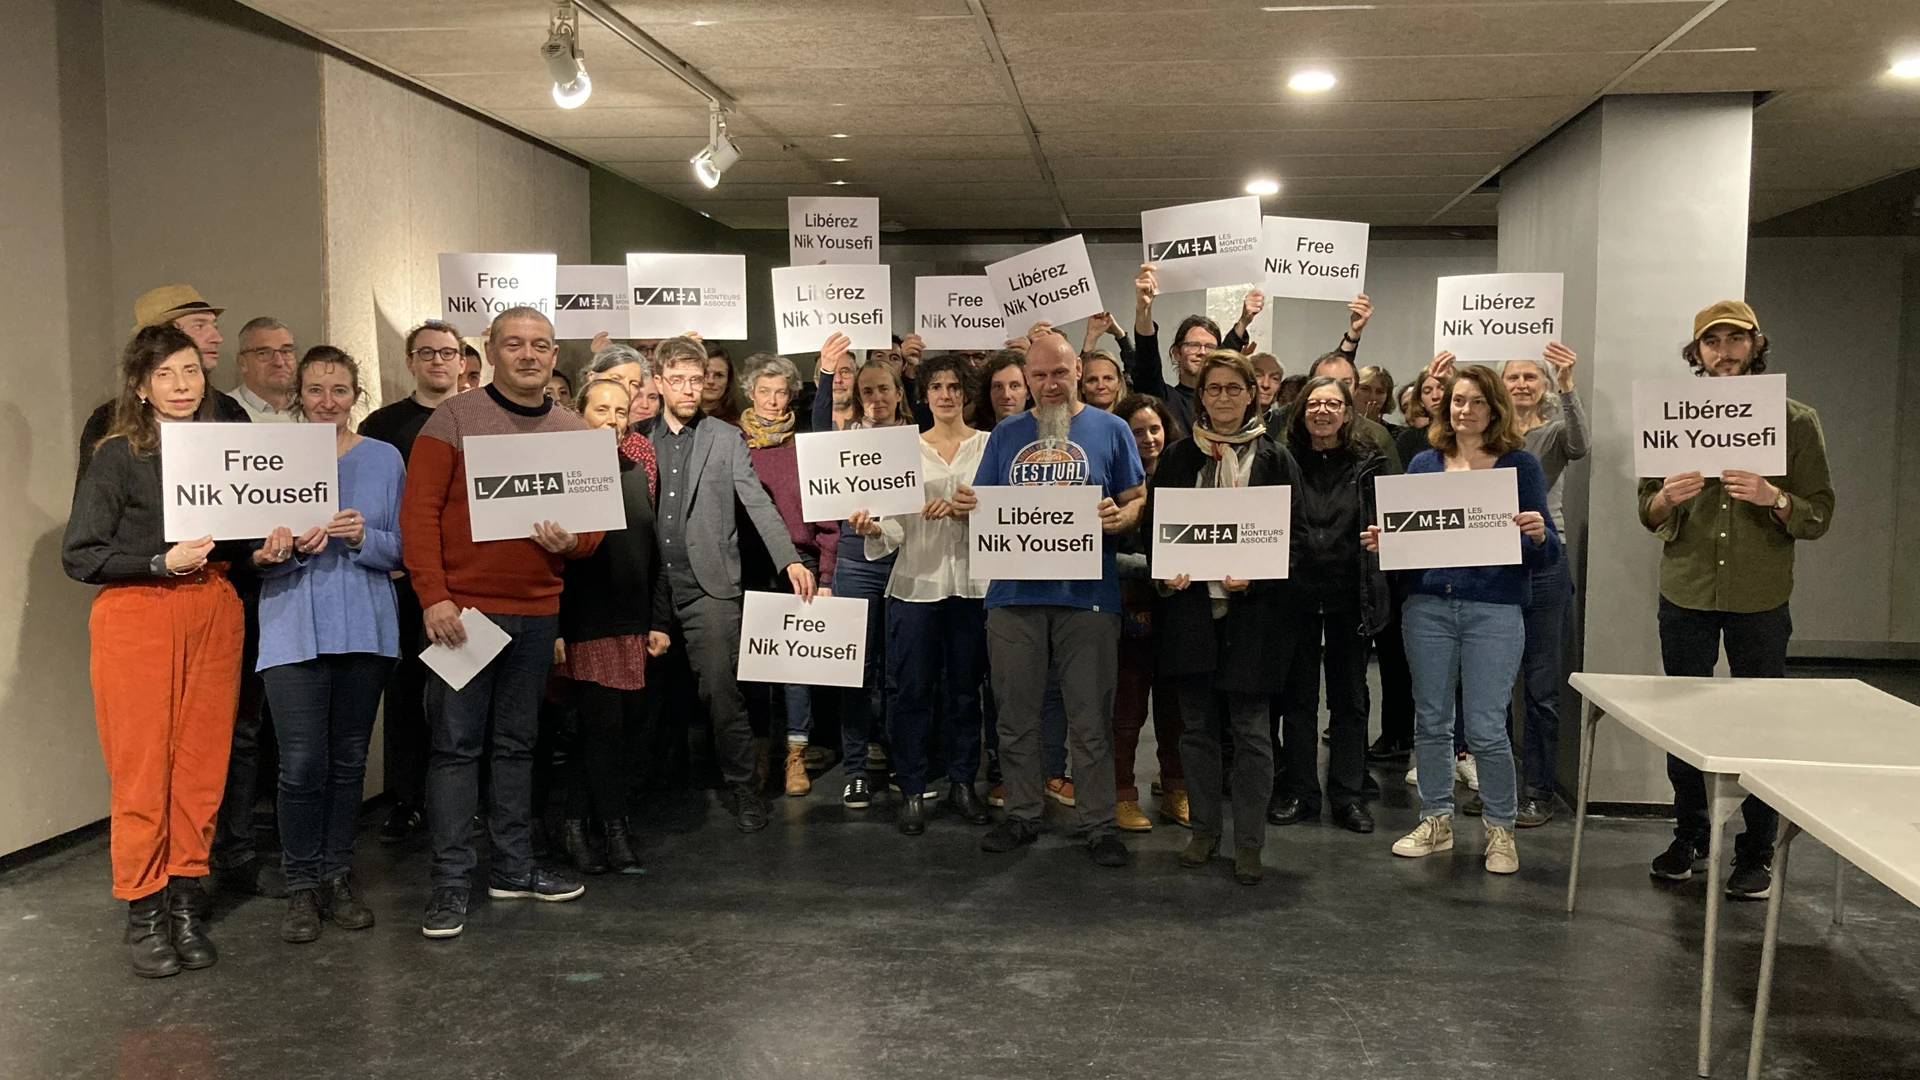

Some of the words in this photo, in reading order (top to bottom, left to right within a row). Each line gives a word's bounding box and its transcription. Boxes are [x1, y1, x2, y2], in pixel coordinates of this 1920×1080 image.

[805, 213, 858, 228] Libérez
[794, 235, 813, 248] Nik
[817, 235, 873, 250] Yousefi
[1219, 233, 1231, 241] LES
[1219, 237, 1257, 246] MONTEURS
[1297, 237, 1334, 253] Free
[1220, 244, 1253, 253] ASSOCIÉS
[1008, 262, 1068, 292] Libérez
[1265, 258, 1292, 274] Nik
[1298, 260, 1359, 278] Yousefi
[478, 272, 519, 289] Free
[448, 297, 476, 313] Nik
[948, 293, 983, 306] Free
[1003, 298, 1027, 318] Nik
[1027, 277, 1090, 308] Yousefi
[1462, 292, 1535, 311] Libérez
[783, 311, 809, 329] Nik
[814, 309, 883, 325] Yousefi
[922, 314, 946, 328] Nik
[1442, 319, 1473, 336] Nik
[1478, 317, 1554, 335] Yousefi
[1664, 400, 1752, 421] Libérez
[1643, 430, 1679, 449] Nik
[1685, 427, 1776, 448] Yousefi
[223, 450, 284, 472] Free
[839, 450, 883, 468] Free
[567, 471, 582, 479] LES
[568, 477, 614, 486] MONTEURS
[1013, 462, 1083, 483] FESTIVAL
[568, 484, 609, 493] ASSOCIÉS
[809, 476, 841, 495] Nik
[845, 471, 917, 493] Yousefi
[176, 484, 223, 507] Nik
[229, 482, 329, 505] Yousefi
[997, 506, 1074, 525] Libérez
[1468, 507, 1482, 515] LES
[1468, 513, 1512, 521] MONTEURS
[978, 533, 1011, 552] Nik
[1017, 533, 1094, 552] Yousefi
[782, 614, 826, 633] Free
[748, 638, 779, 656] Nik
[784, 640, 857, 661] Yousefi
